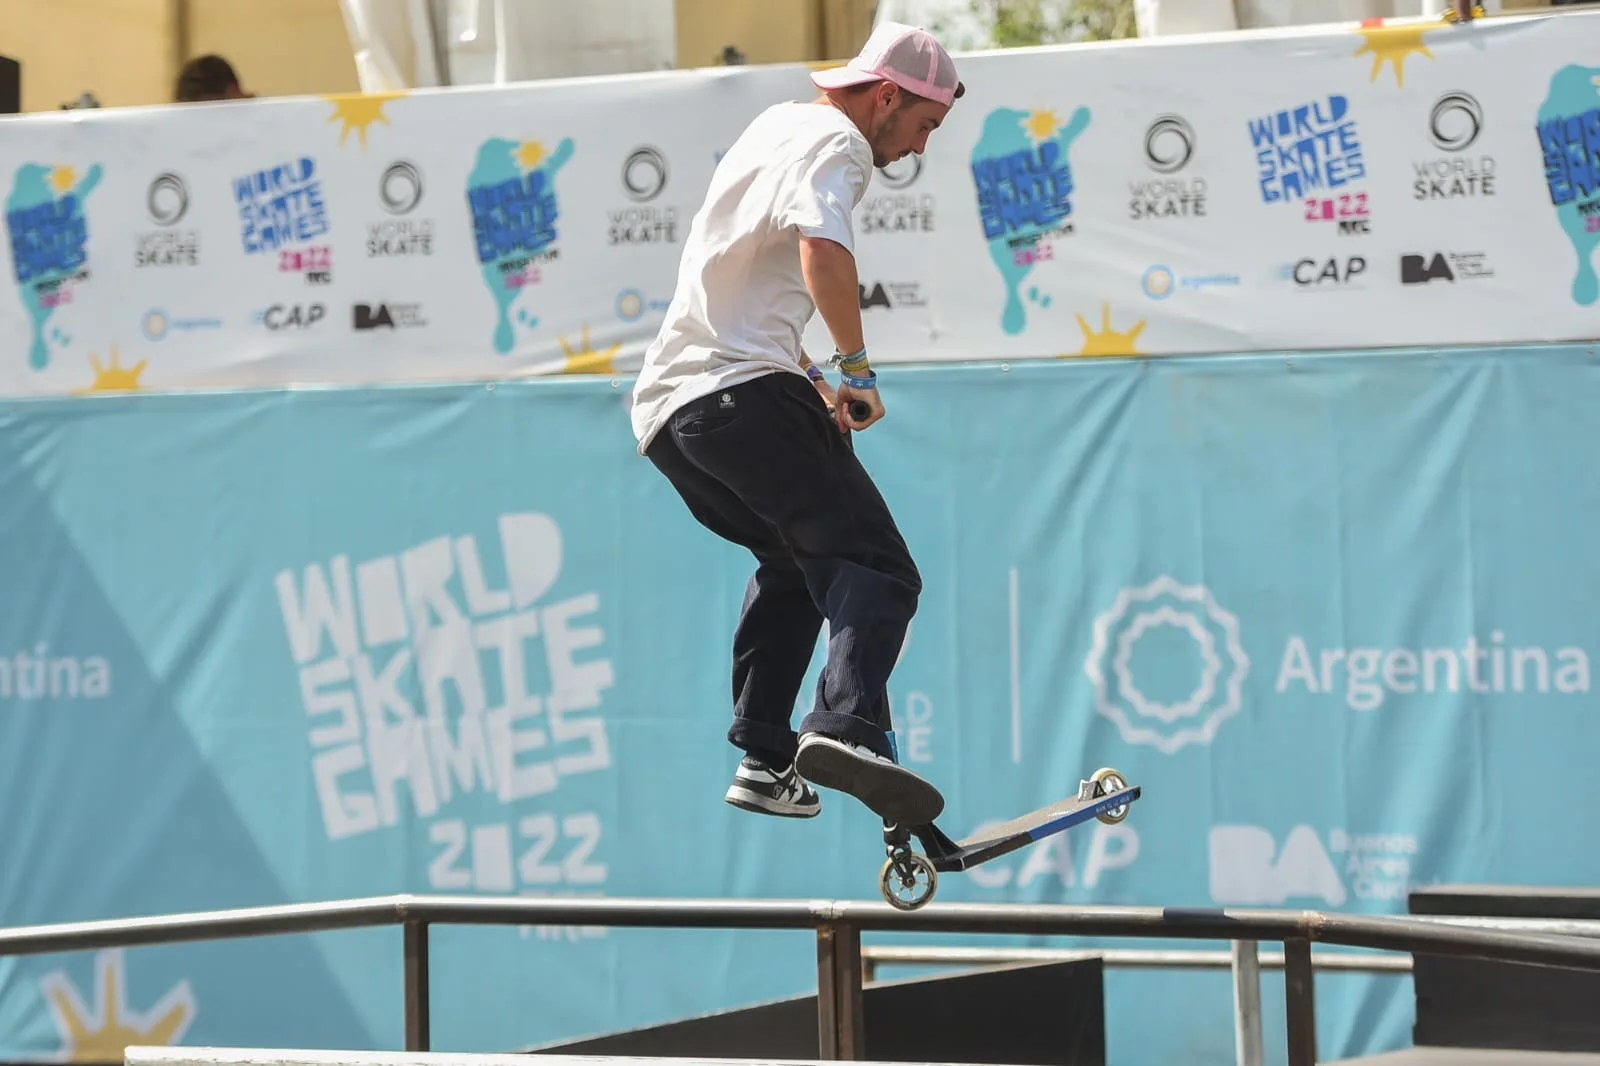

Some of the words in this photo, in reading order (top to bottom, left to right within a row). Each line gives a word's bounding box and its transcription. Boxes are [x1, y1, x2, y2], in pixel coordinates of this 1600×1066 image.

[1247, 95, 1350, 147] WORLD
[1257, 121, 1361, 178] SKATE
[1261, 153, 1366, 203] GAMES
[1412, 156, 1496, 178] WORLD
[1128, 178, 1207, 200] WORLD
[1413, 175, 1496, 201] SKATE
[607, 206, 677, 225] WORLD
[861, 195, 935, 214] WORLD
[1129, 194, 1207, 220] SKATE
[1304, 193, 1370, 221] 2022
[366, 221, 433, 238] WORLD
[607, 222, 677, 246] SKATE
[861, 209, 936, 234] SKATE
[366, 235, 432, 257] SKATE
[1293, 255, 1367, 286] CAP
[1401, 252, 1454, 284] BA
[263, 304, 326, 331] CAP
[352, 303, 396, 331] BA
[274, 512, 563, 664] WORLD
[300, 592, 616, 748] SKATE
[1275, 630, 1591, 711] Argentina
[312, 694, 611, 841] GAMES
[428, 812, 608, 891] 2022
[1208, 825, 1348, 906] BA
